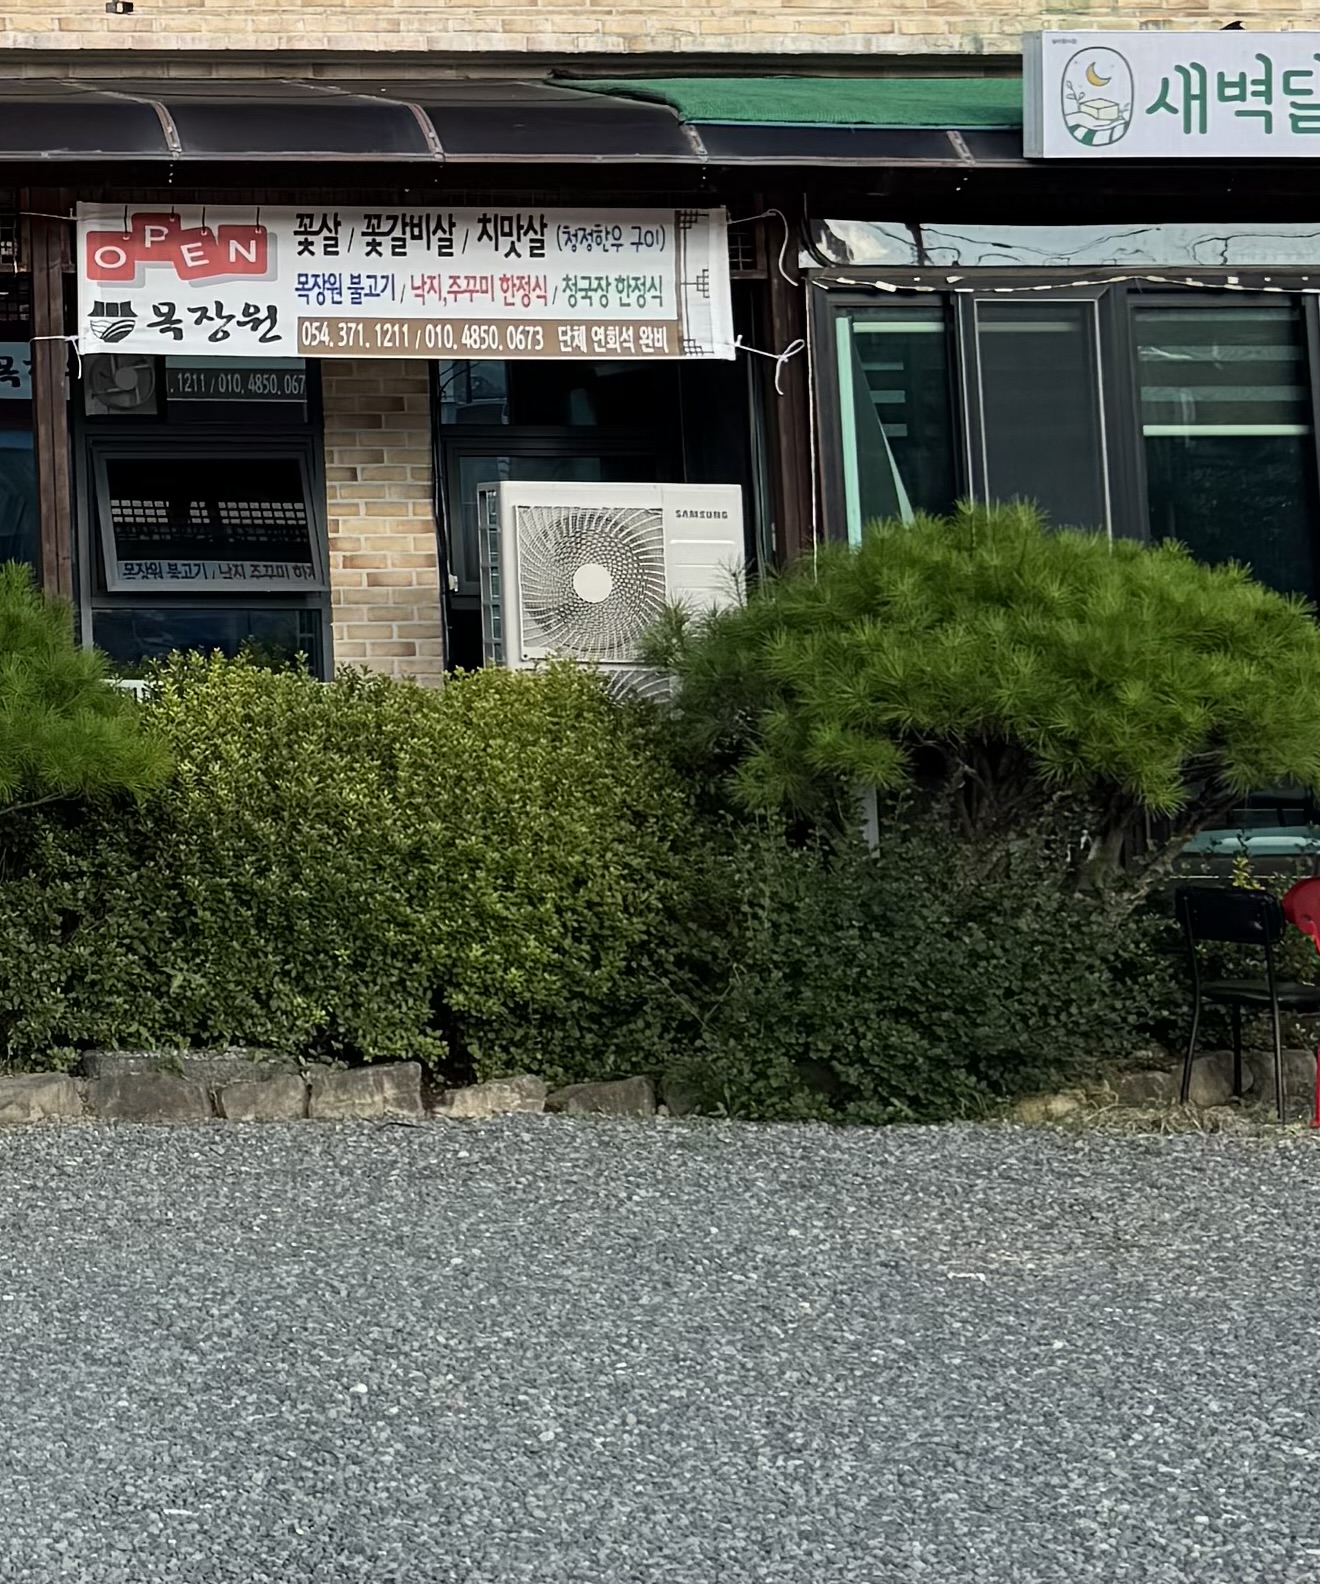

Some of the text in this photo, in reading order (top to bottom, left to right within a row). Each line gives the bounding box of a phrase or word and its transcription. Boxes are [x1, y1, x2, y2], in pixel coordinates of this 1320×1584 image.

[94, 225, 256, 269] OPEN
[293, 212, 341, 256] 꽃살
[361, 213, 456, 257] 꽃갈비살
[477, 213, 548, 258] 치맛살
[295, 272, 343, 306] 목장원
[347, 273, 395, 305] 불고기
[499, 274, 548, 307] 한정식
[562, 274, 611, 308] 청국장
[616, 275, 663, 308] 한정식
[146, 300, 282, 342] 목장원
[558, 325, 587, 353] 단체
[591, 326, 635, 353] 연회석
[639, 326, 669, 354] 완비
[675, 509, 728, 519] SAMSUNG
